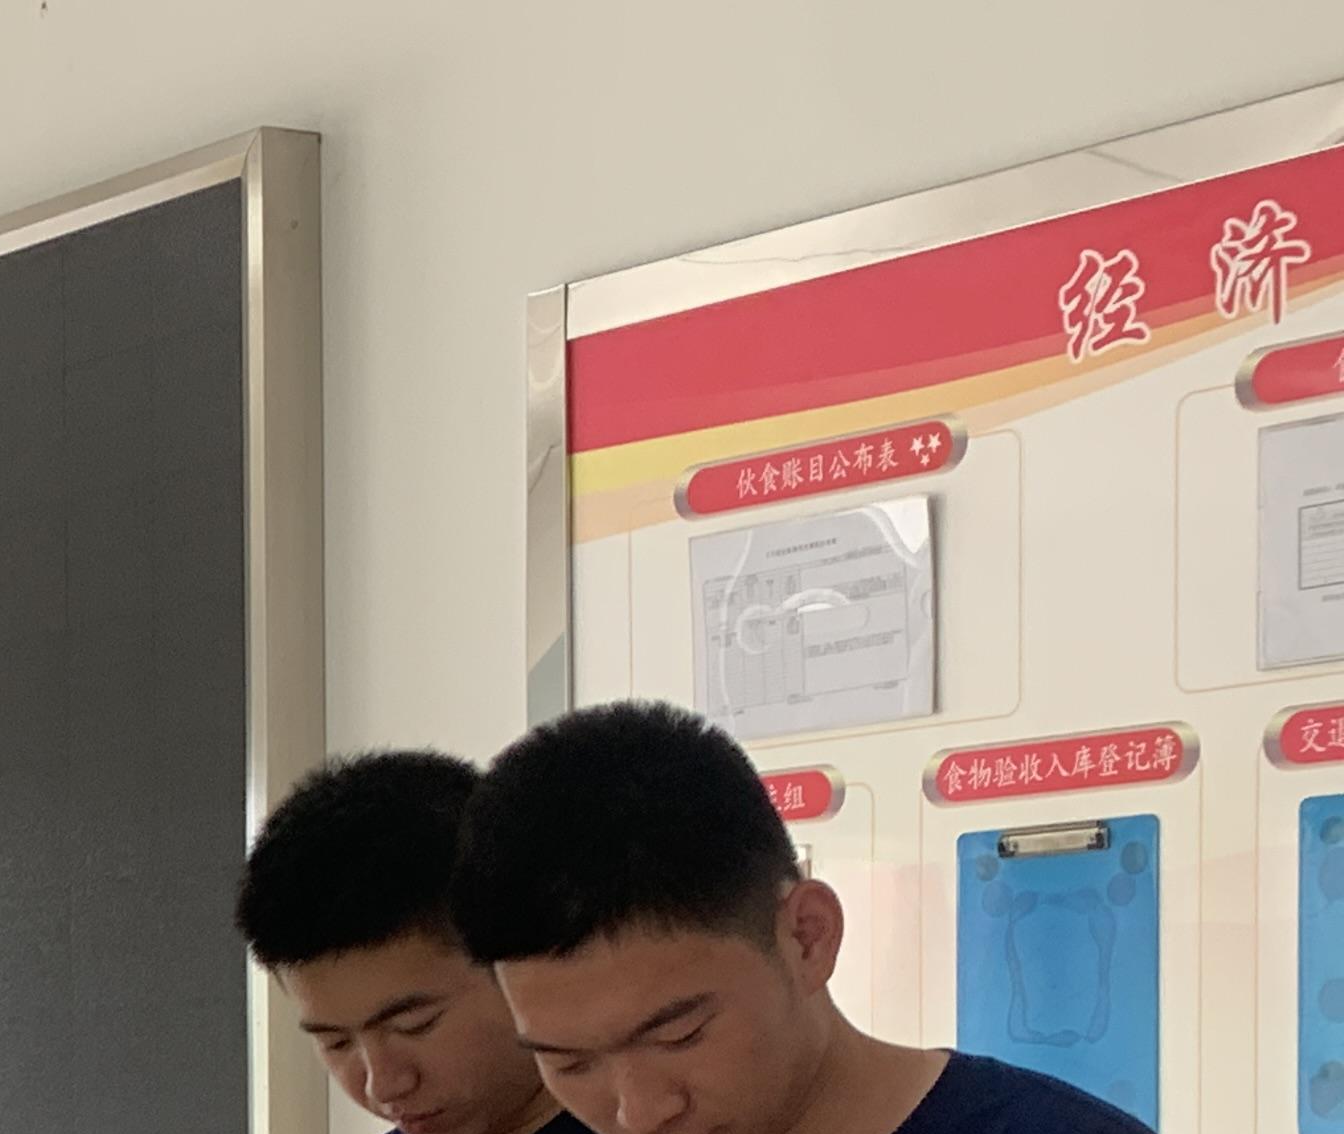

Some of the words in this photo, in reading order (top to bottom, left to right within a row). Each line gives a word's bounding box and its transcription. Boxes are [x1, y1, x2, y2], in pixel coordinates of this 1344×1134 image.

[735, 438, 900, 499] 伙食账目公布表
[943, 734, 1178, 795] 食物验收入库登记簿
